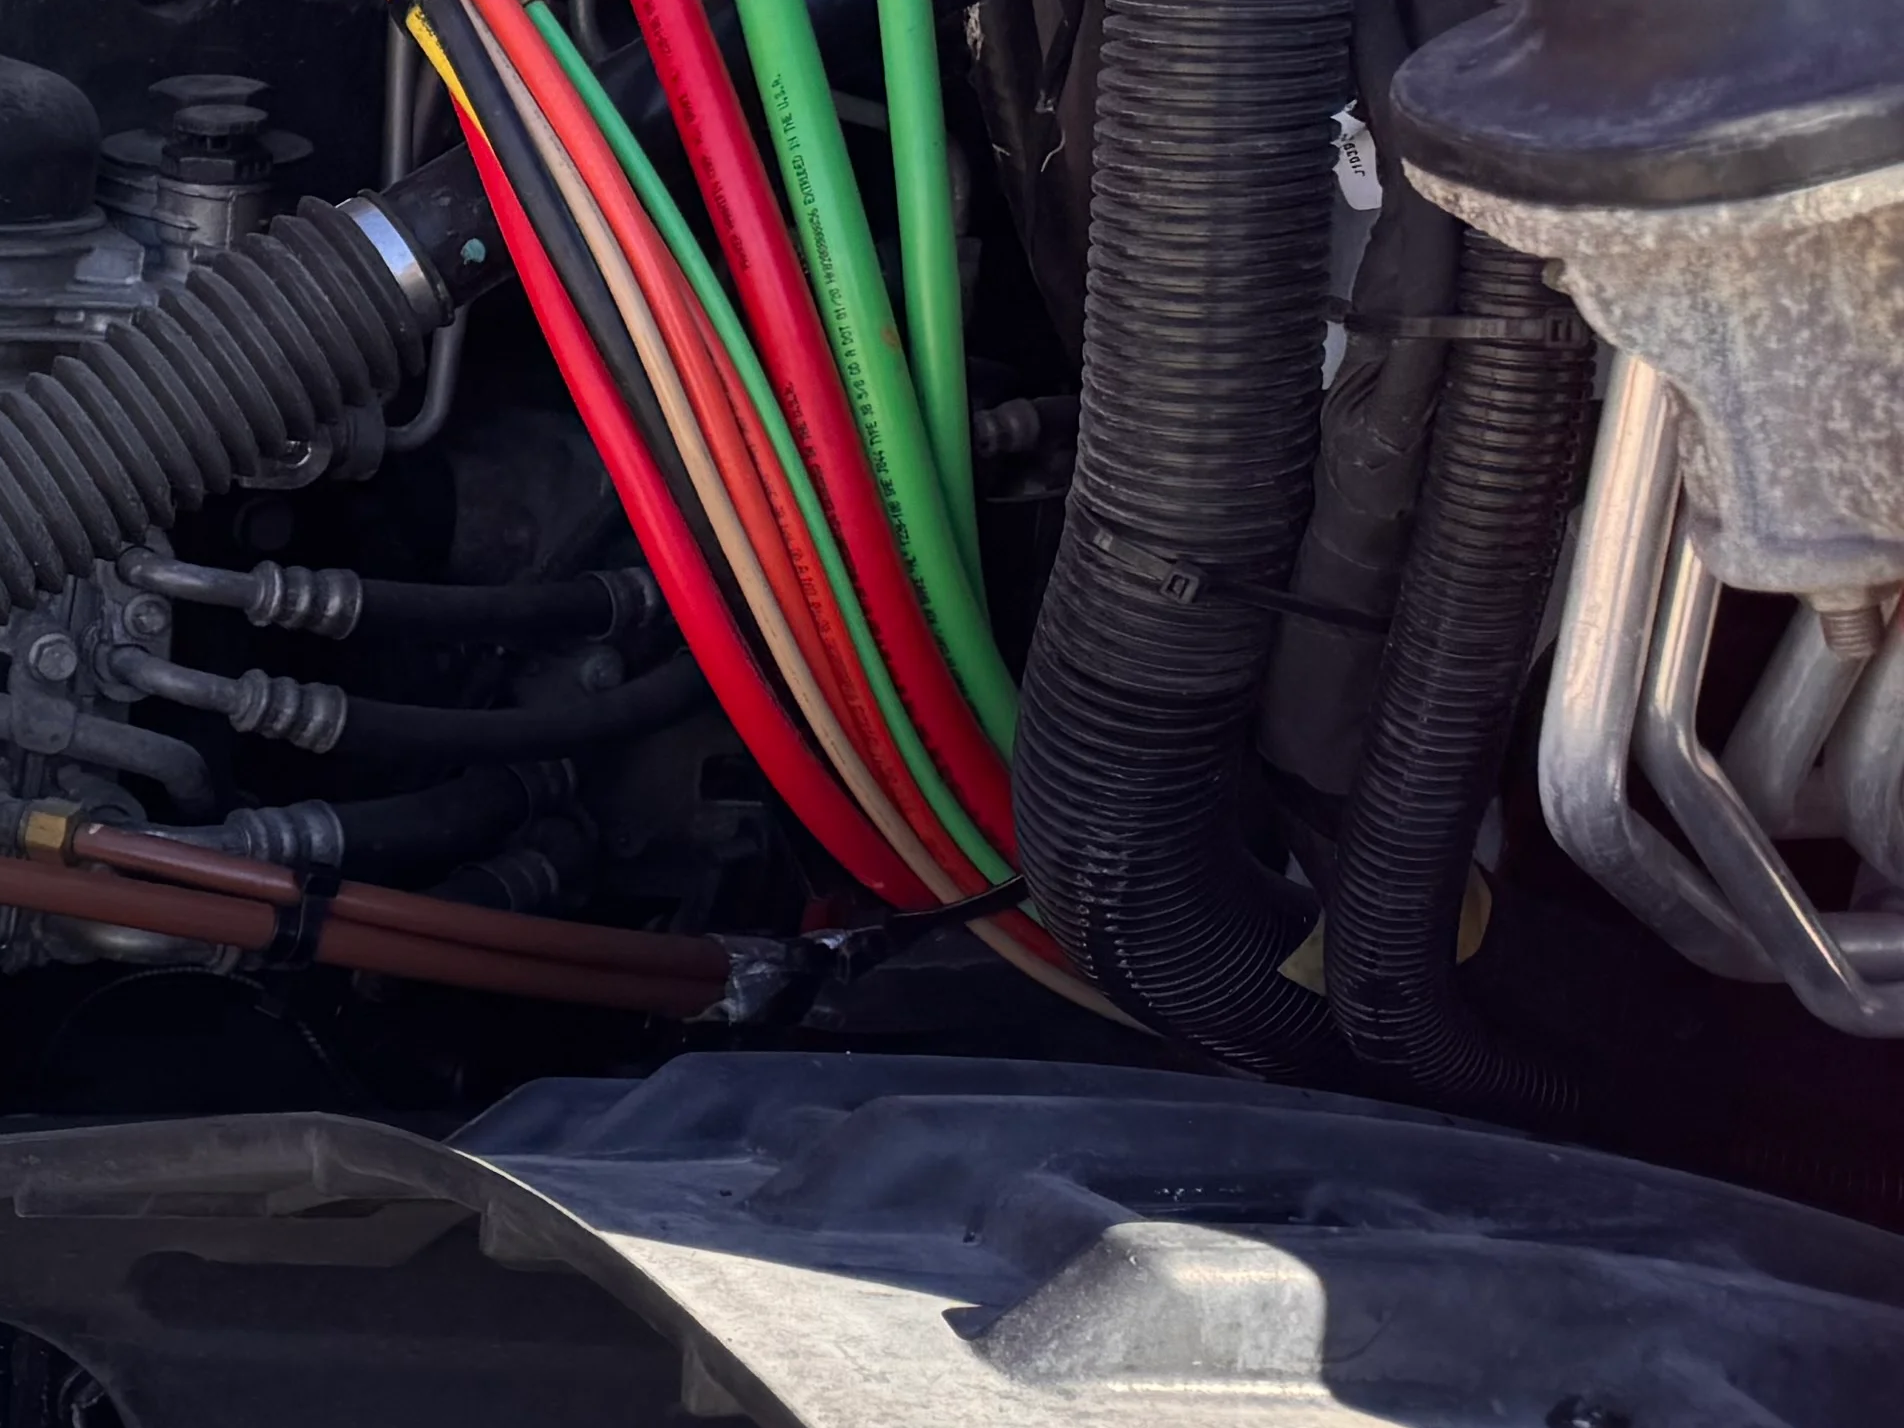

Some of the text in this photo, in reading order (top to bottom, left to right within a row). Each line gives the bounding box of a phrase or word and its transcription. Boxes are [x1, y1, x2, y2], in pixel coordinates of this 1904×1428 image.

[779, 111, 797, 132] THE
[836, 323, 854, 346] DOT
[862, 419, 884, 446] TYPE
